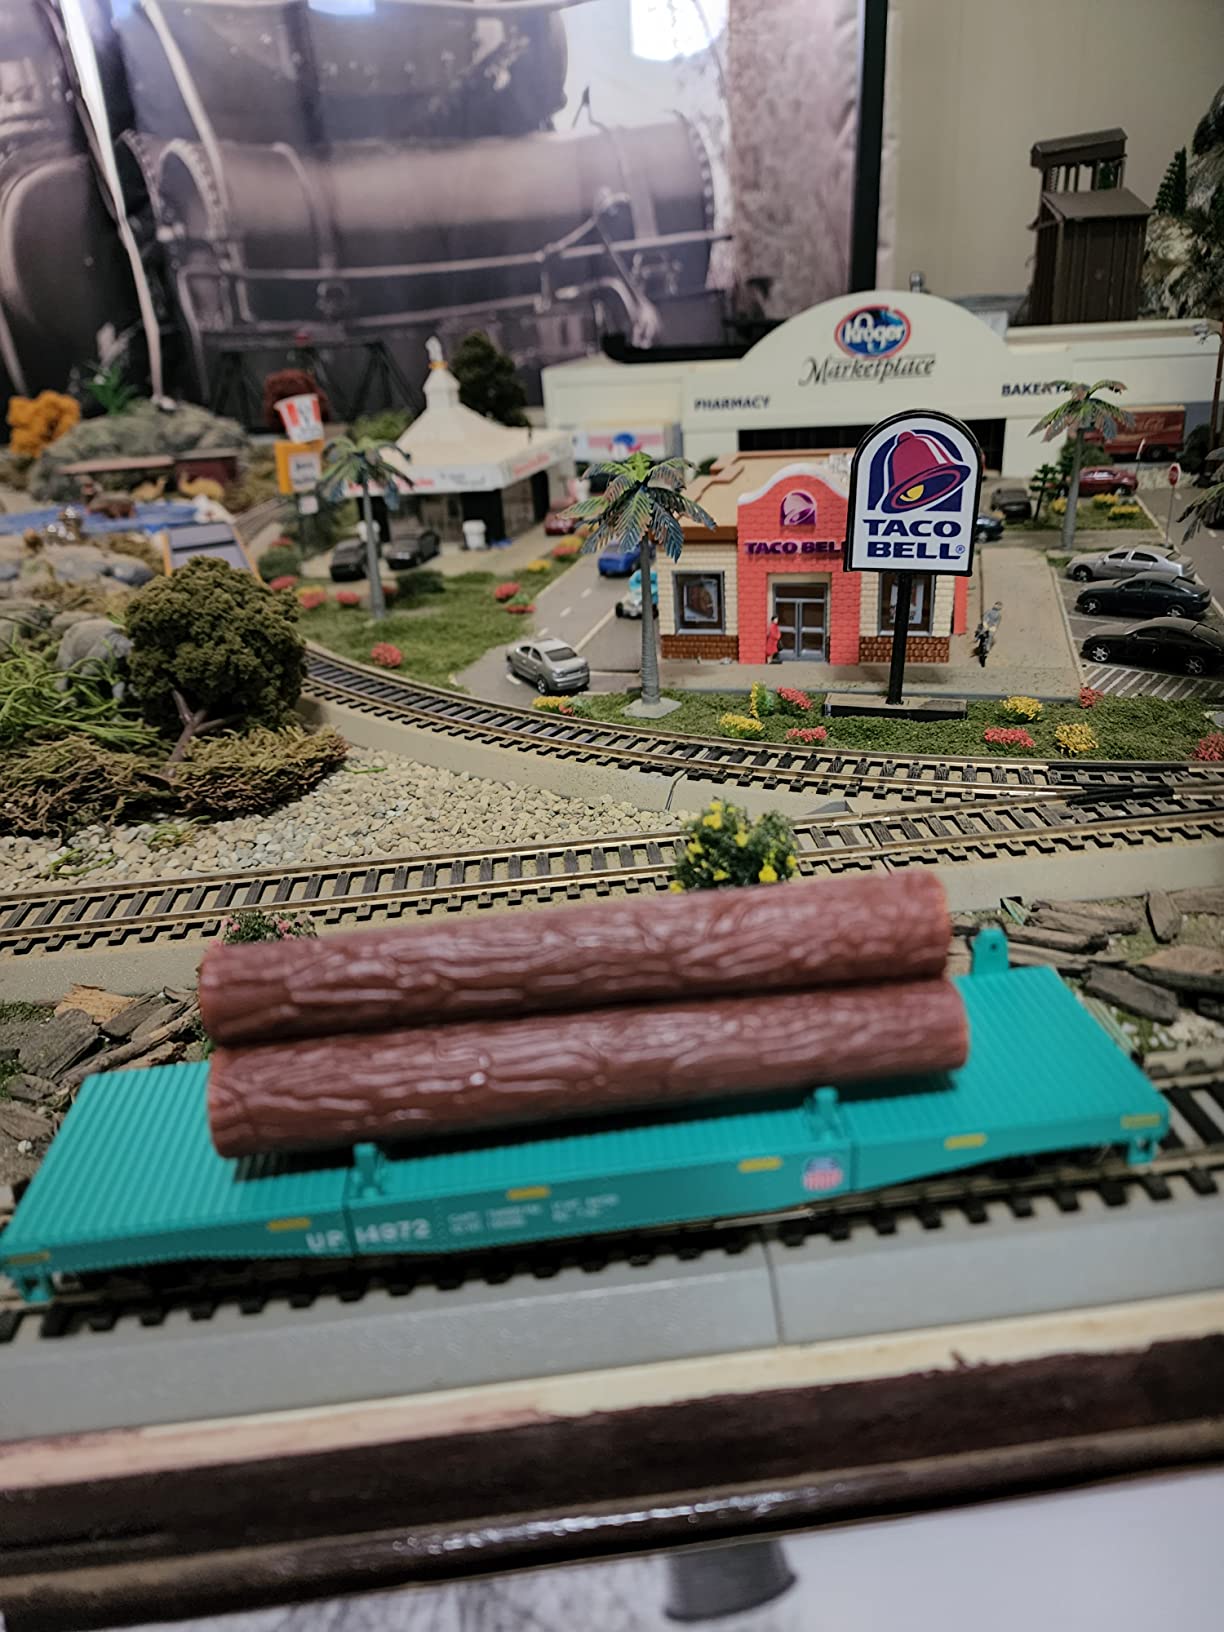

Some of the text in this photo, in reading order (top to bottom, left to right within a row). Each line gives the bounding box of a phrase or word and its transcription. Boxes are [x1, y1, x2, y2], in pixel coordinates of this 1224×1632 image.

[843, 312, 906, 353] Kroger
[798, 354, 936, 386] Marketplace
[694, 395, 770, 411] PHARMACY
[863, 519, 961, 537] TACO
[745, 541, 799, 555] TACO
[305, 1228, 345, 1253] UP
